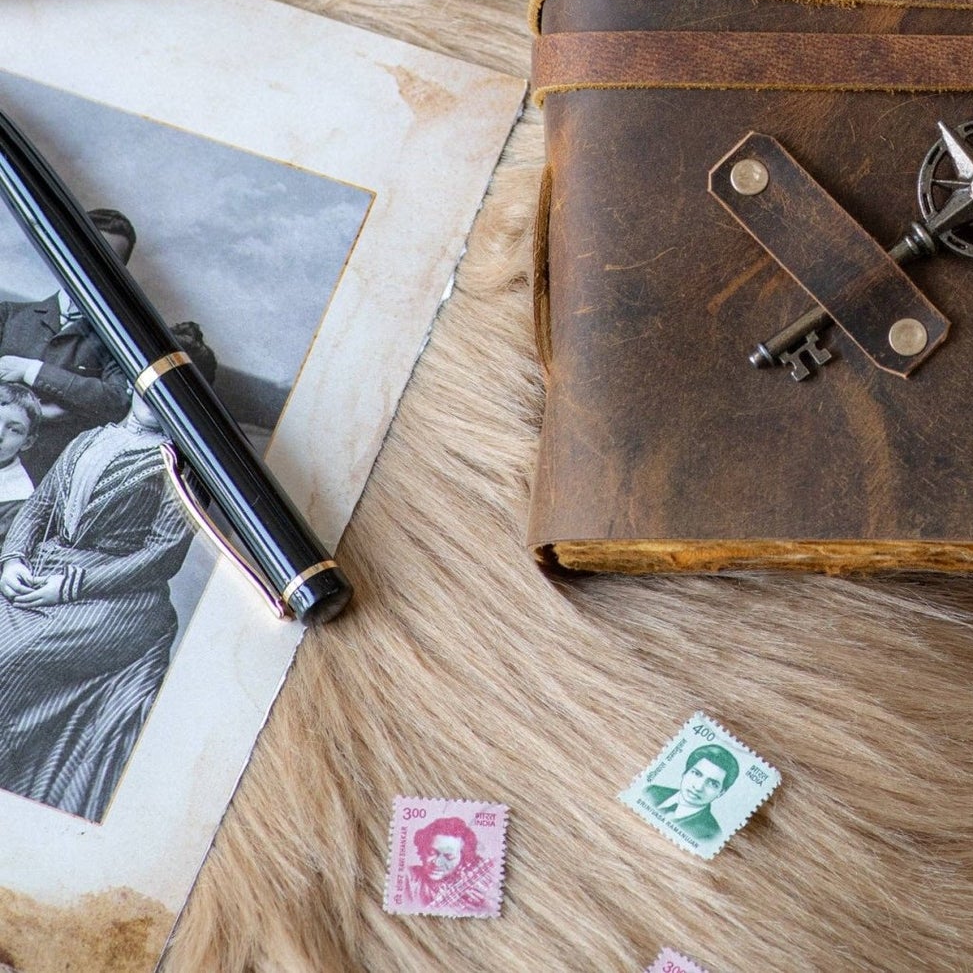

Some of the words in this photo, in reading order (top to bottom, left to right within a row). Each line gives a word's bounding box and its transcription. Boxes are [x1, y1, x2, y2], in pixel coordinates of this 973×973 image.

[692, 724, 716, 742] 400
[745, 770, 763, 787] INDIA
[750, 764, 769, 781] भारत
[402, 807, 426, 821] 300
[474, 812, 497, 821] भारत
[636, 798, 667, 824] SRINIVASA
[665, 817, 699, 849] RAMANUJAN
[399, 826, 408, 857] SHANKAR
